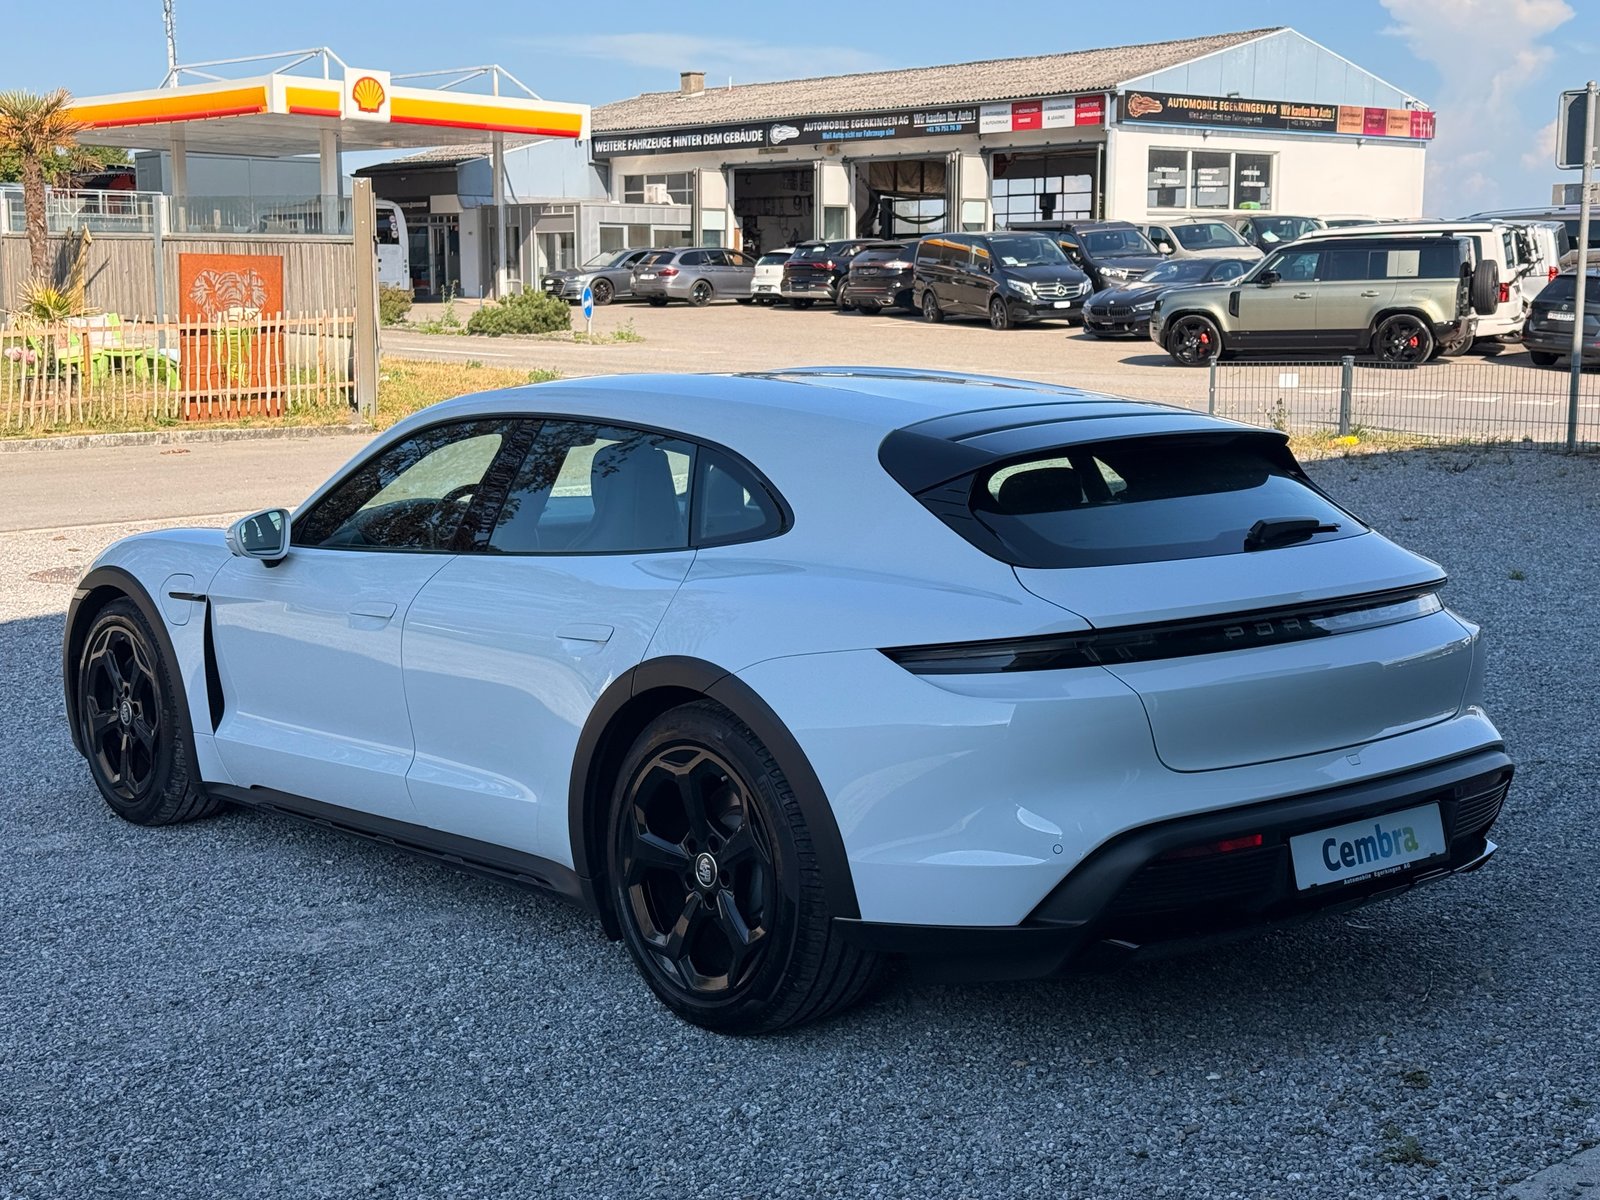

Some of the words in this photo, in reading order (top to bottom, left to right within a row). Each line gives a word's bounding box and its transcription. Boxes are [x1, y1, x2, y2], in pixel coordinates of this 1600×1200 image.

[1168, 97, 1217, 110] AUTOMOBILE
[1219, 101, 1265, 114] EGERKINGEN
[1266, 104, 1277, 114] AG
[1281, 104, 1290, 116] Wir
[803, 120, 849, 132] AUTOMOBILE
[851, 116, 897, 129] EGERKINGEN
[898, 115, 909, 125] AG
[913, 113, 925, 124] Wir
[926, 112, 946, 123] kaufen
[957, 110, 972, 121] Auto
[594, 140, 627, 153] WEITERE
[628, 136, 671, 151] FAHRZEUGE
[673, 134, 702, 147] HINTER
[703, 132, 722, 145] DEM
[723, 128, 763, 144] GEBÄUDE
[1322, 824, 1419, 871] Cembra
[1344, 873, 1372, 885] Automobile
[1374, 866, 1402, 877] Egerkingen
